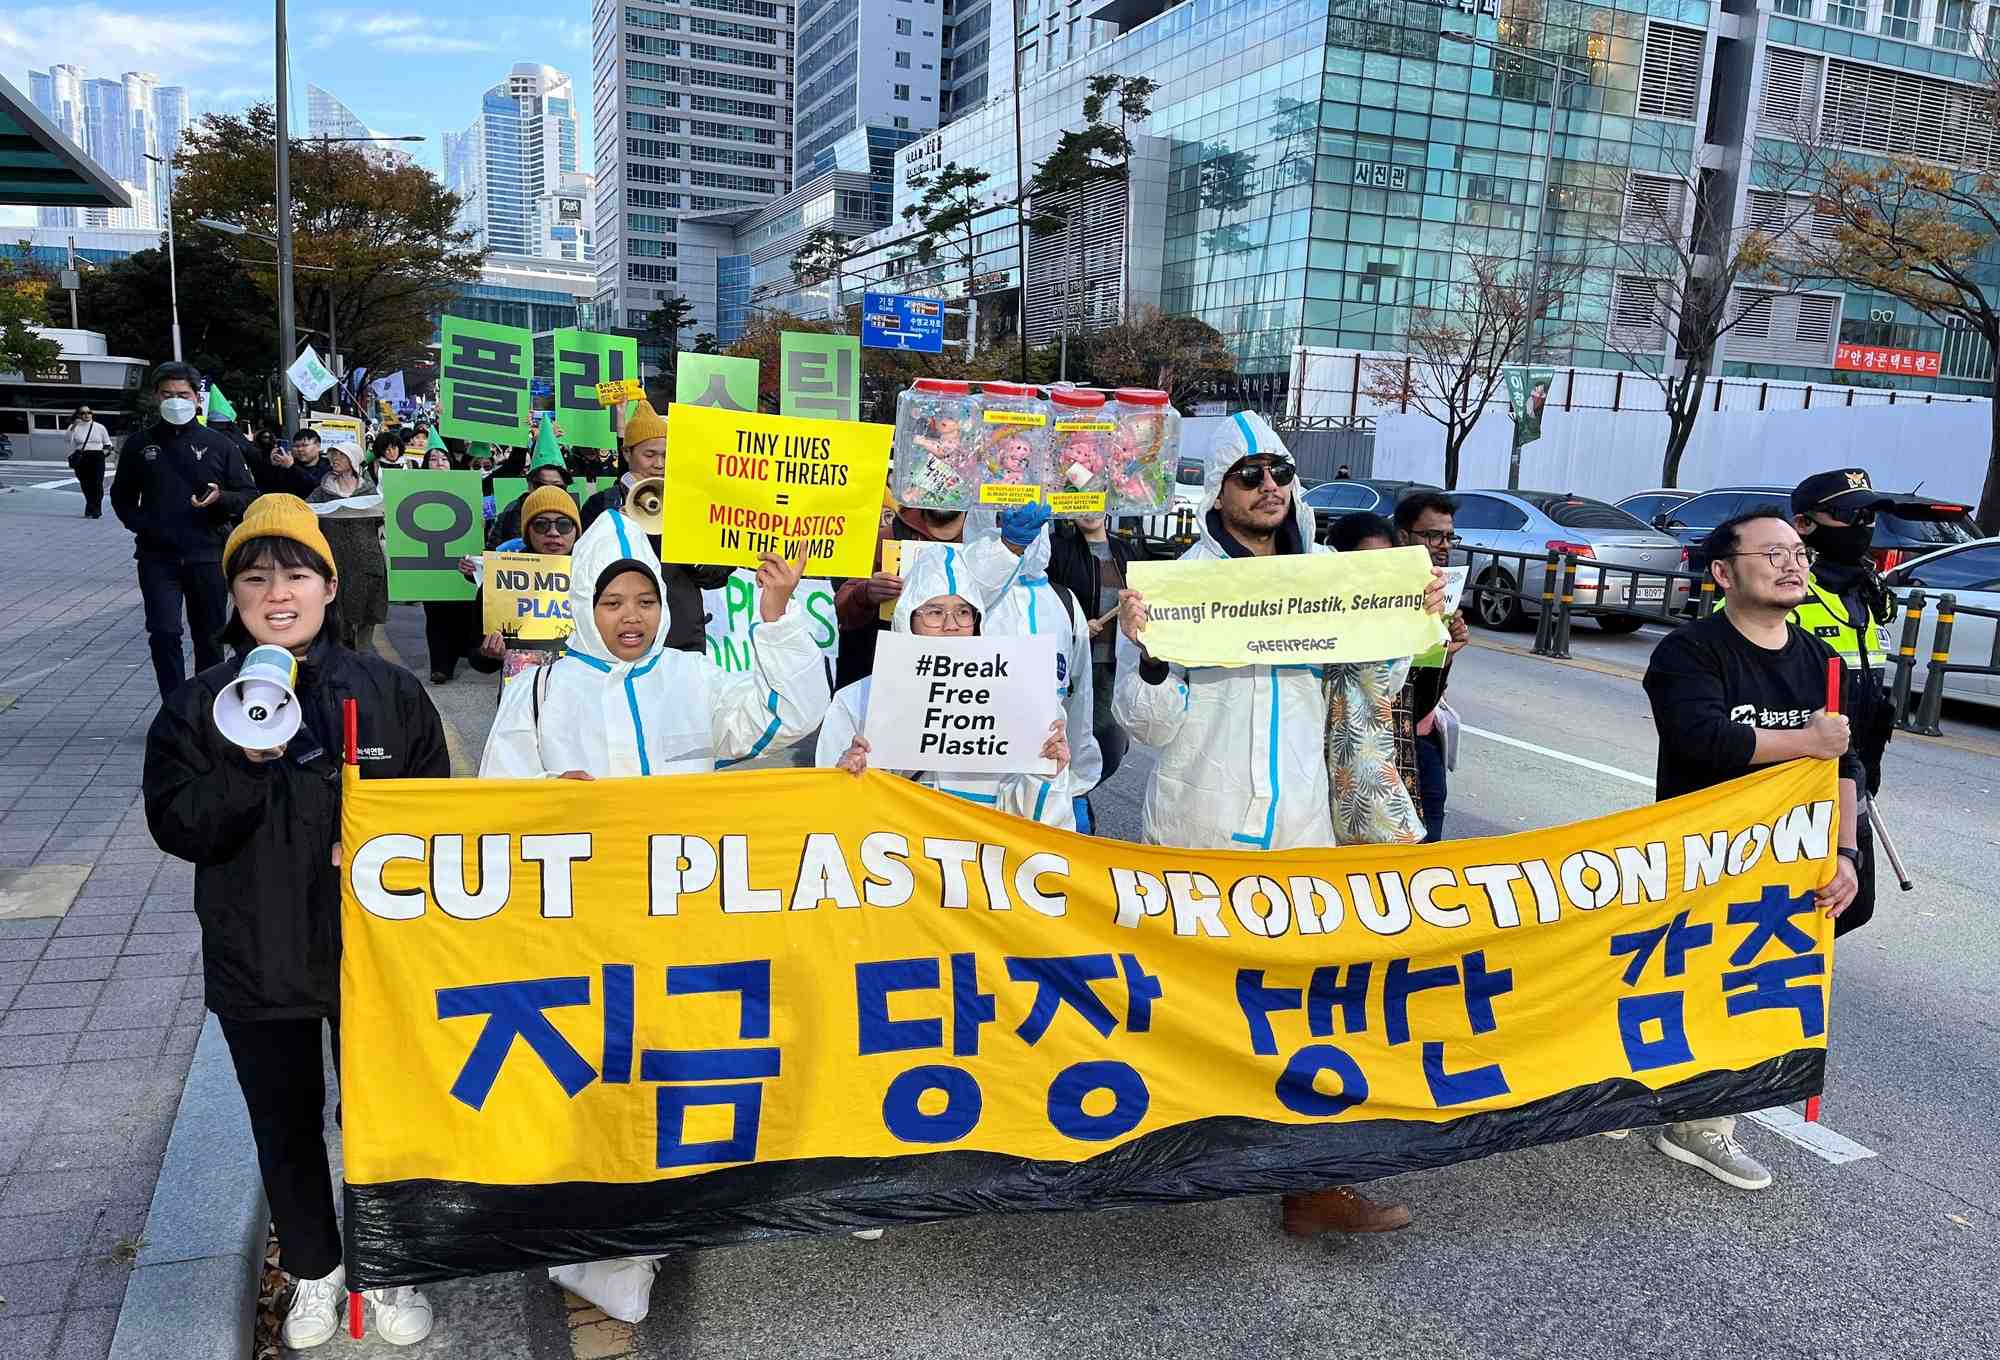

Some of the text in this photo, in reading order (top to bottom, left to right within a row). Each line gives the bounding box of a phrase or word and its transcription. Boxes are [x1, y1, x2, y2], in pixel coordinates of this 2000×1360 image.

[1356, 163, 1404, 188] 사진관
[444, 335, 528, 427] 플
[736, 430, 830, 460] TINY LIVES
[715, 454, 848, 486] TOXIC THREATS
[390, 490, 473, 571] 오
[709, 503, 846, 537] MICROPLASTICS
[721, 528, 835, 560] IN THE WMB
[496, 570, 570, 592] NO MO
[517, 598, 573, 619] PLAS
[1144, 602, 1206, 623] Kurangi
[1211, 599, 1283, 619] Produksi
[1287, 596, 1346, 614] Plastik,
[1247, 637, 1338, 653] GREENPEACE
[915, 653, 1008, 678] #Break
[928, 682, 990, 704] Free
[924, 708, 995, 730] From
[920, 733, 1009, 755] Plastic
[350, 800, 1834, 939] CUT PLASTIC PRODUCTION NOW
[435, 884, 1825, 1169] 지금 당장 생산 감축
